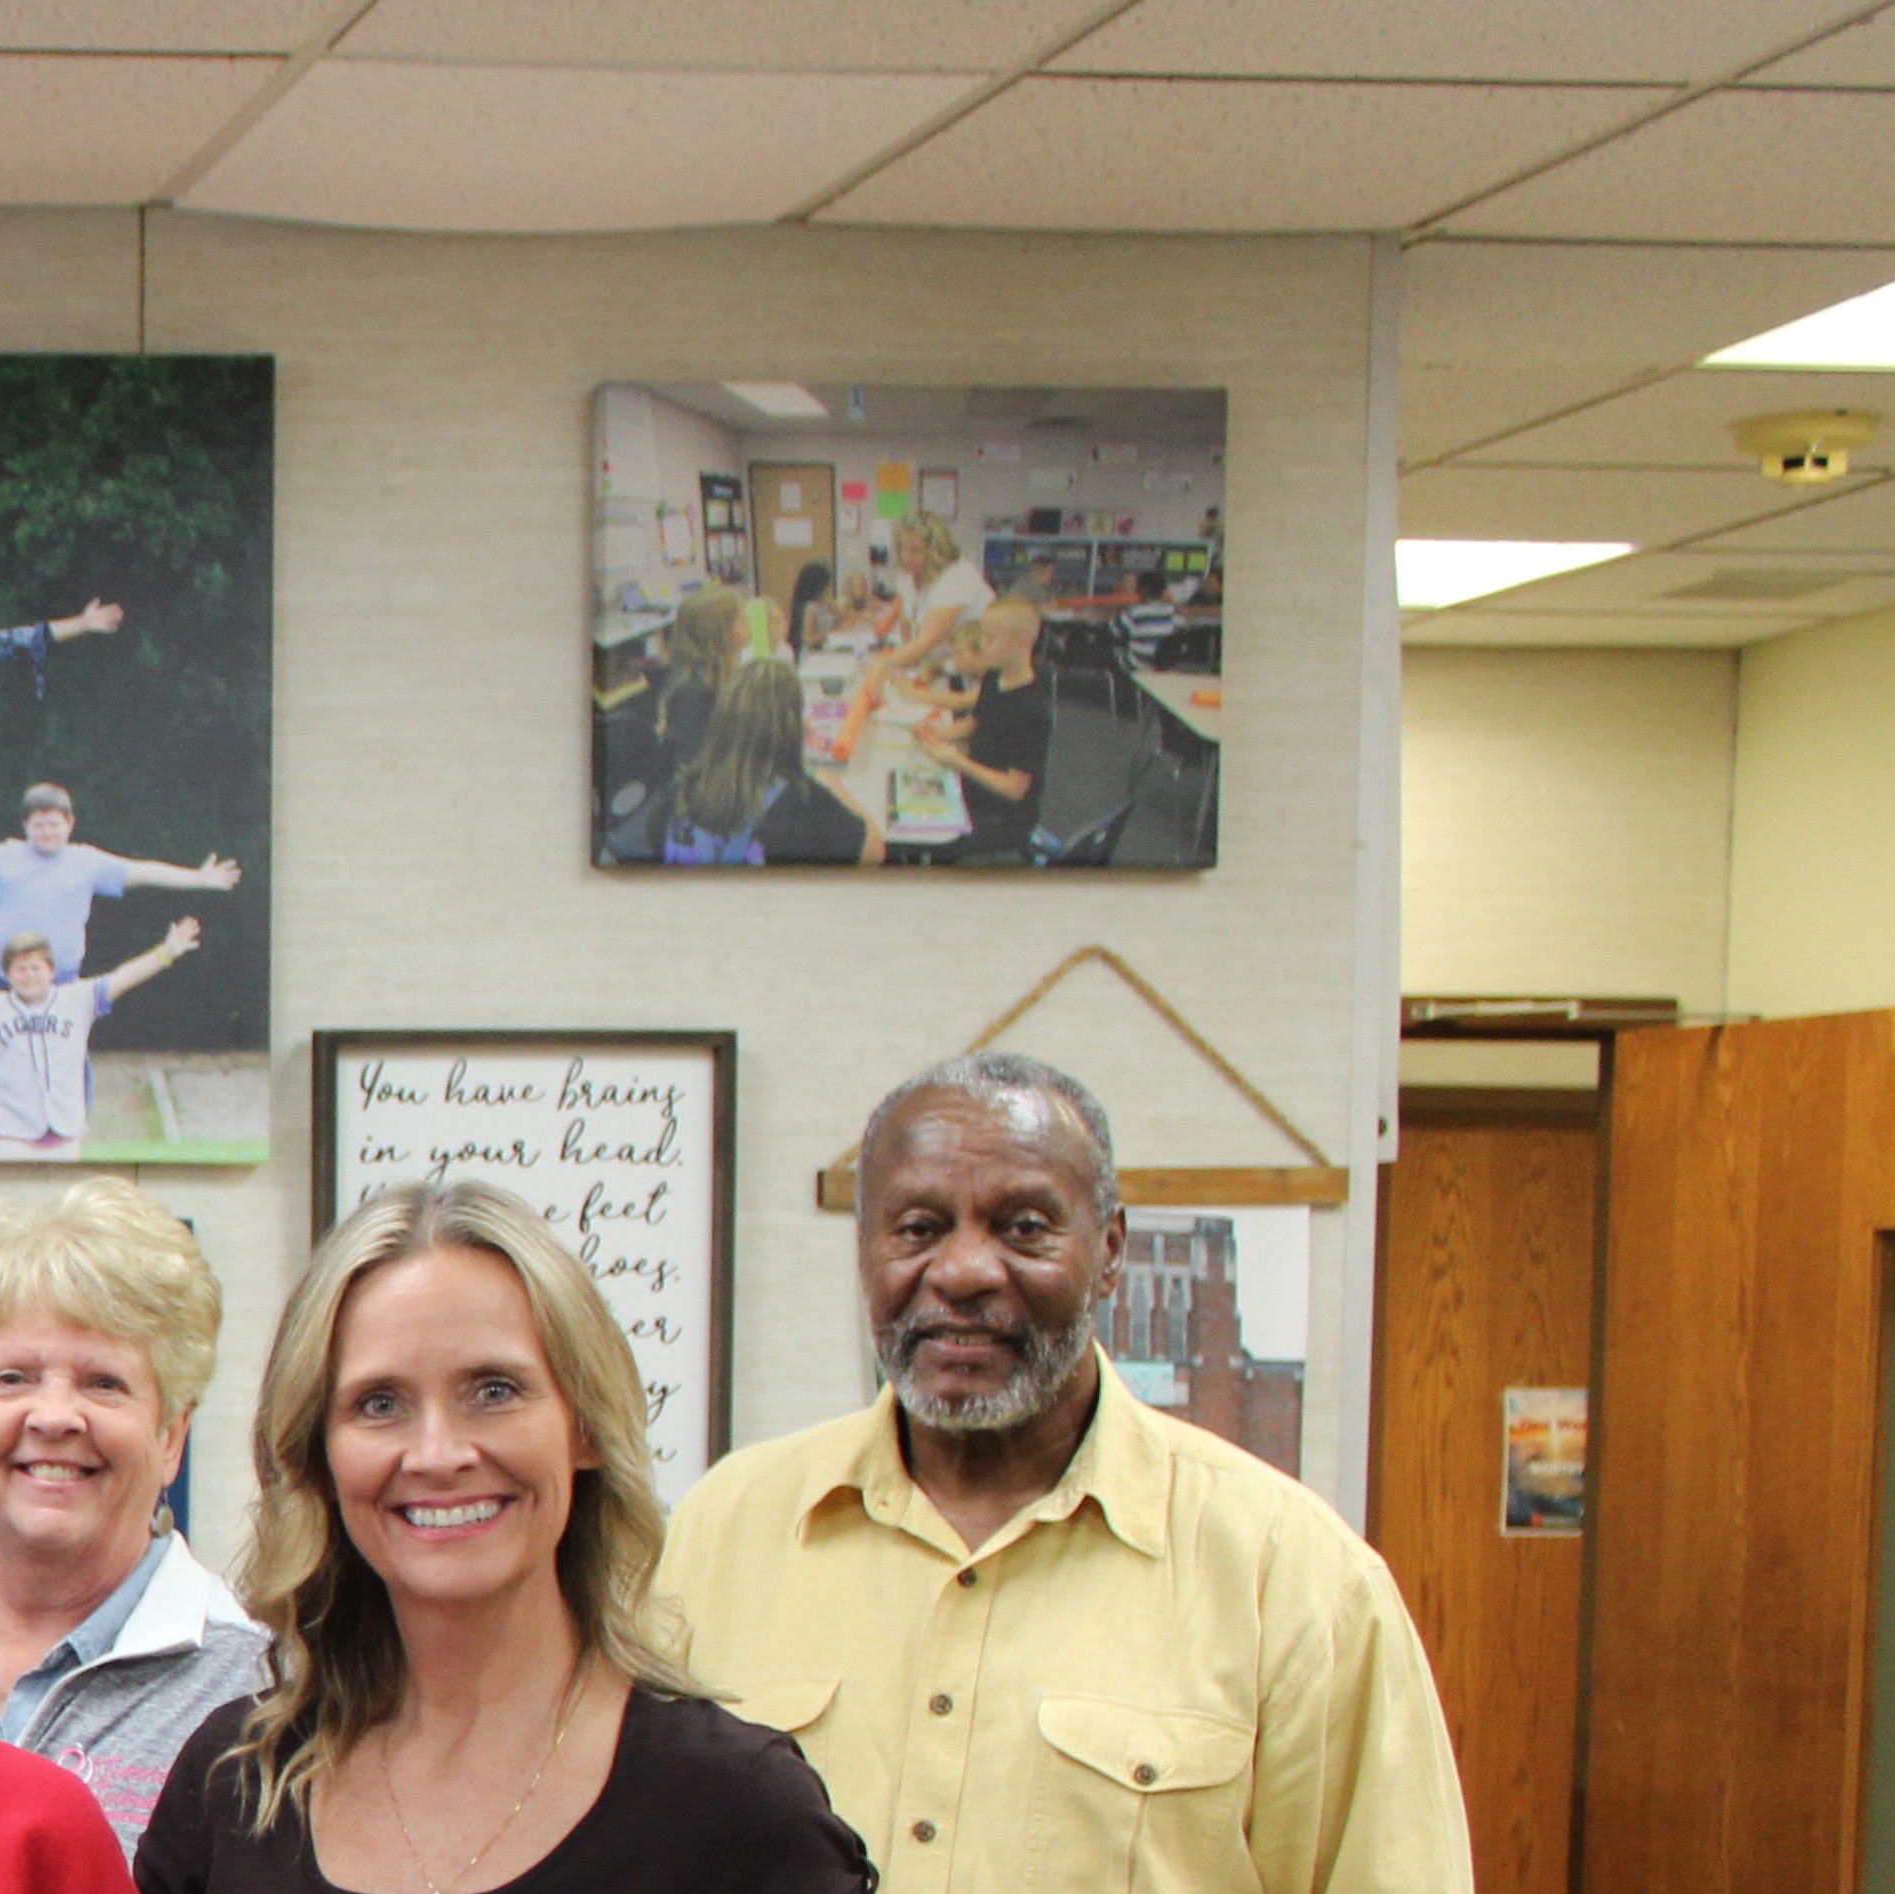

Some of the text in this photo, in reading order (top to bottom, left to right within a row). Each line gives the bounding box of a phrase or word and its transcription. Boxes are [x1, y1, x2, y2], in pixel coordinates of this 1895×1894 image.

[359, 1056, 686, 1117] You have brains
[359, 1117, 684, 1182] in your head.
[578, 1181, 671, 1233] feet
